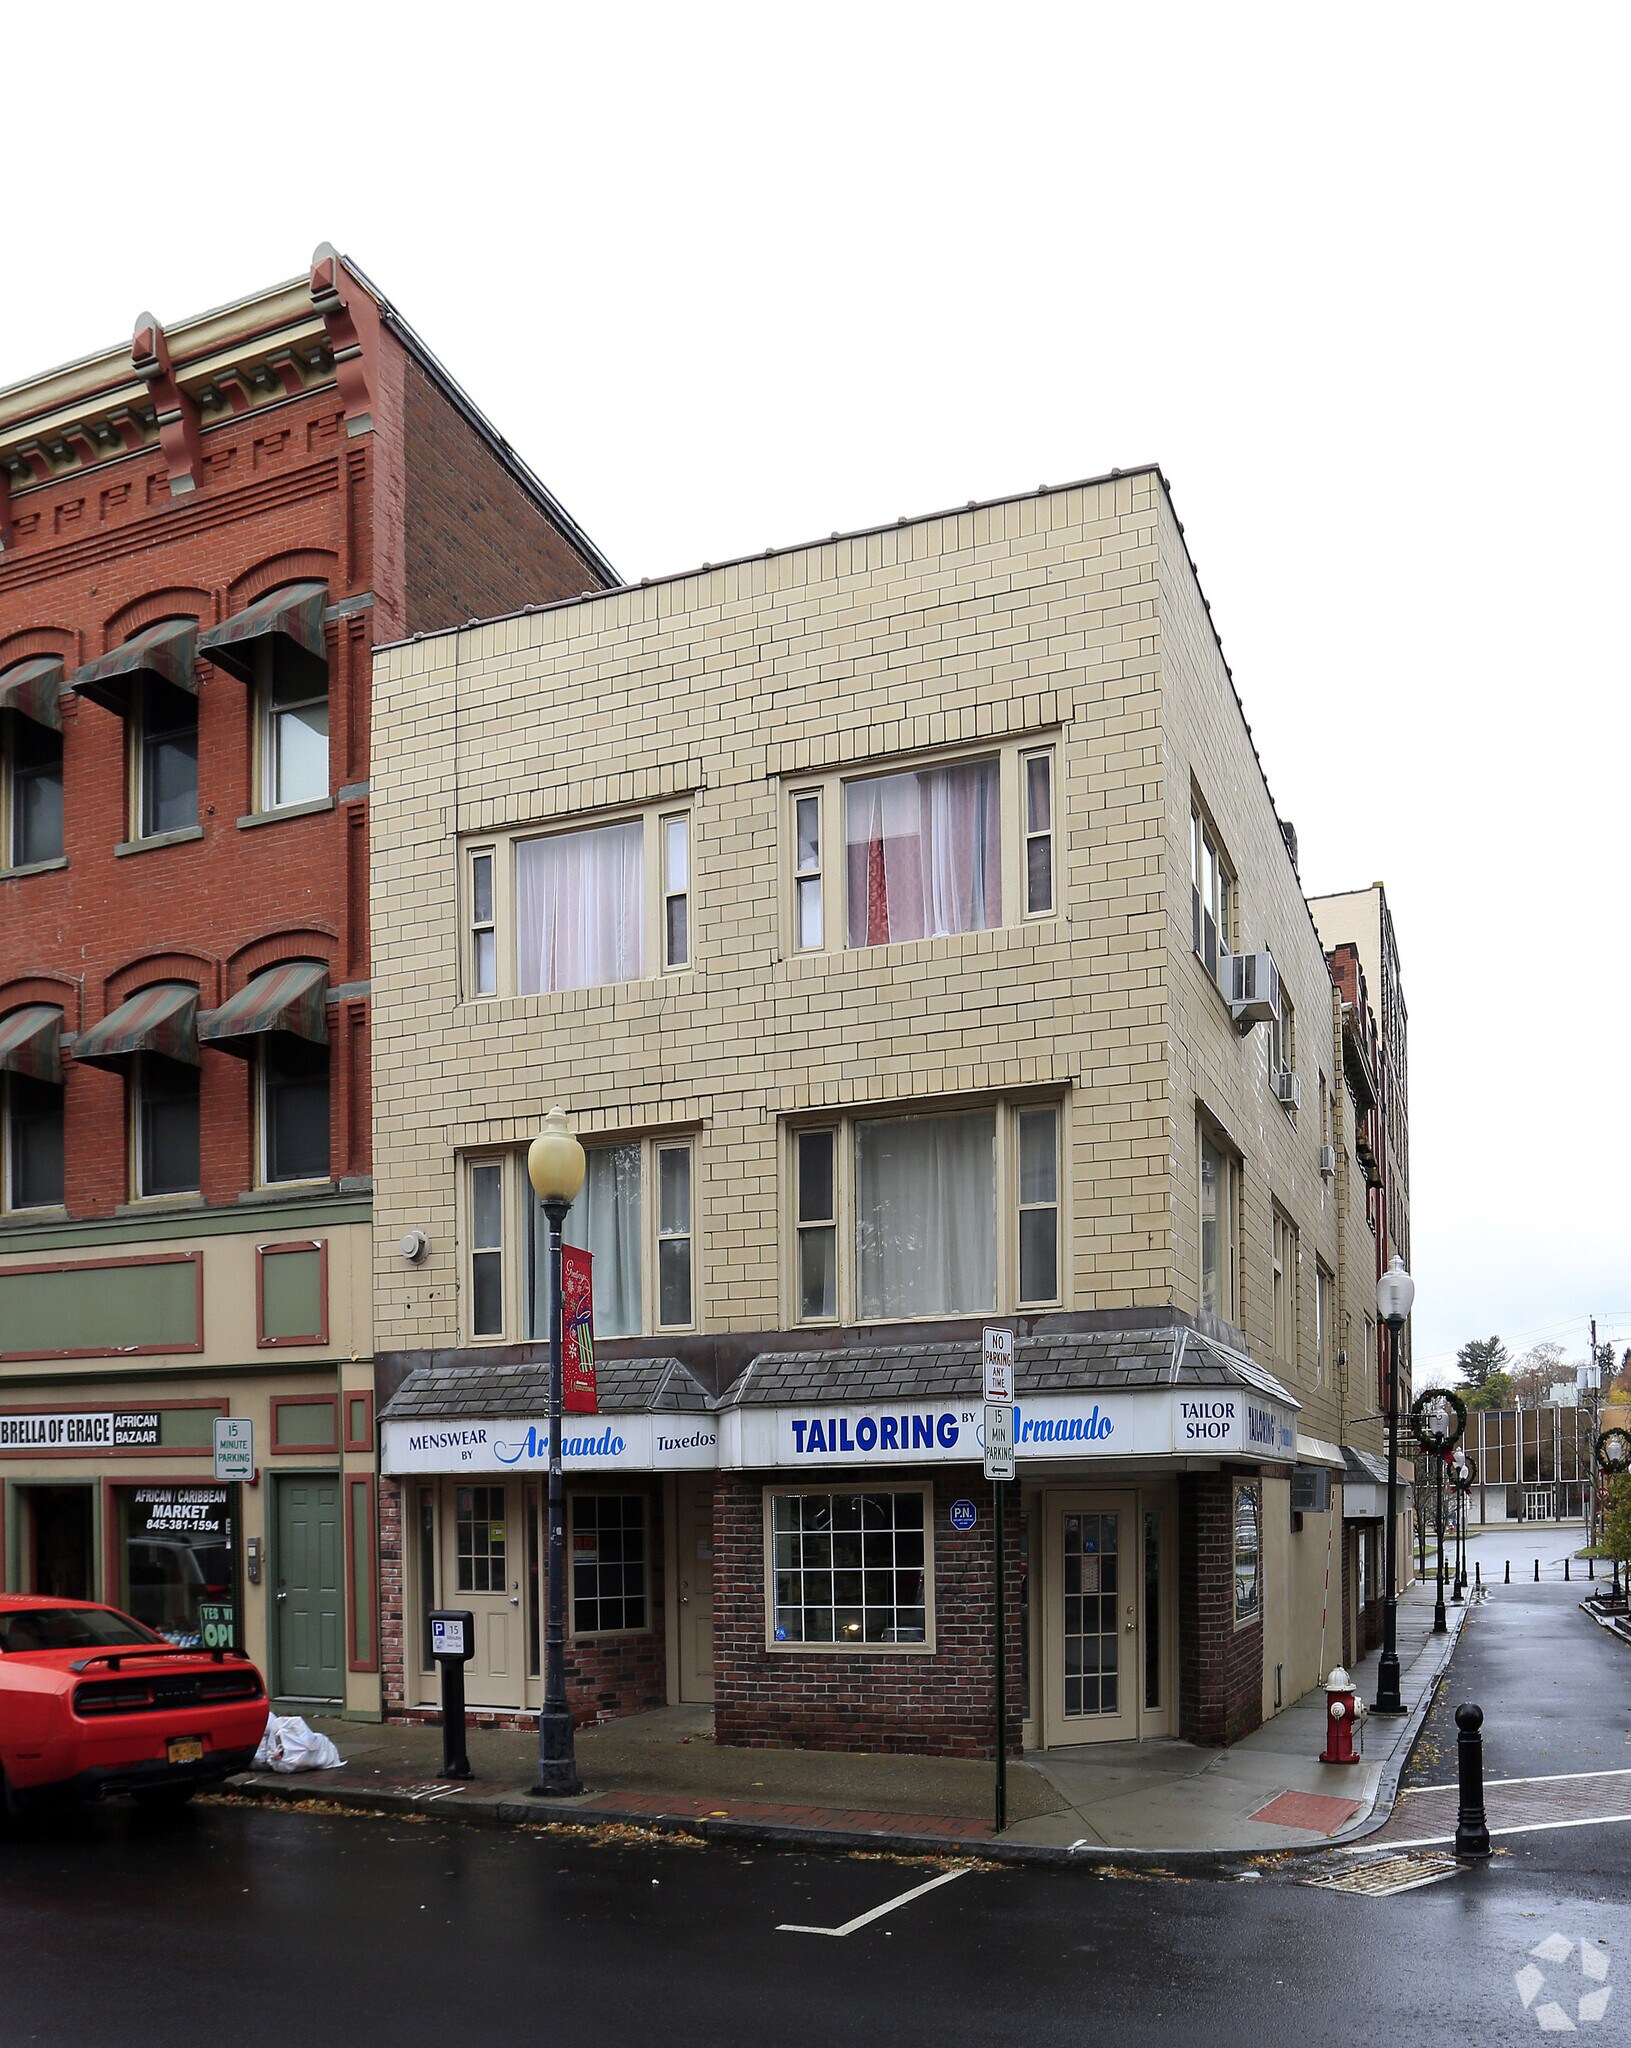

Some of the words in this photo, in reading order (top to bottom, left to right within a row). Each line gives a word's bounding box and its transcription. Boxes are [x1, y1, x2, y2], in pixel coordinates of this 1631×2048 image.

[992, 1335, 1004, 1350] NO
[985, 1350, 1012, 1367] PARKING
[992, 1366, 1005, 1377] ANY
[992, 1378, 1006, 1389] TIME
[994, 1409, 1003, 1424] 15
[1180, 1402, 1235, 1420] TAILOR
[114, 1414, 158, 1428] AFRICAN
[48, 1419, 64, 1443] OF
[67, 1418, 110, 1443] GRACE
[115, 1430, 157, 1444] BAZAAR
[228, 1424, 239, 1437] 15
[792, 1413, 960, 1453] TAILORING
[961, 1411, 977, 1423] BY
[992, 1428, 1006, 1442] MIN
[1186, 1421, 1231, 1439] SHOP
[219, 1439, 248, 1450] MINUTE
[409, 1429, 488, 1451] MENSWEAR
[656, 1431, 717, 1452] Tuxedos
[218, 1453, 250, 1464] PARKING
[461, 1450, 474, 1461] BY
[986, 1446, 1012, 1461] PARKING
[135, 1489, 171, 1503] AFRICAN
[177, 1489, 227, 1503] CARIBBEAN
[152, 1504, 209, 1519] MARKET
[954, 1507, 973, 1518] P.N.
[146, 1519, 219, 1531] 845-381-1594
[202, 1607, 219, 1620] YES
[449, 1625, 459, 1635] 15
